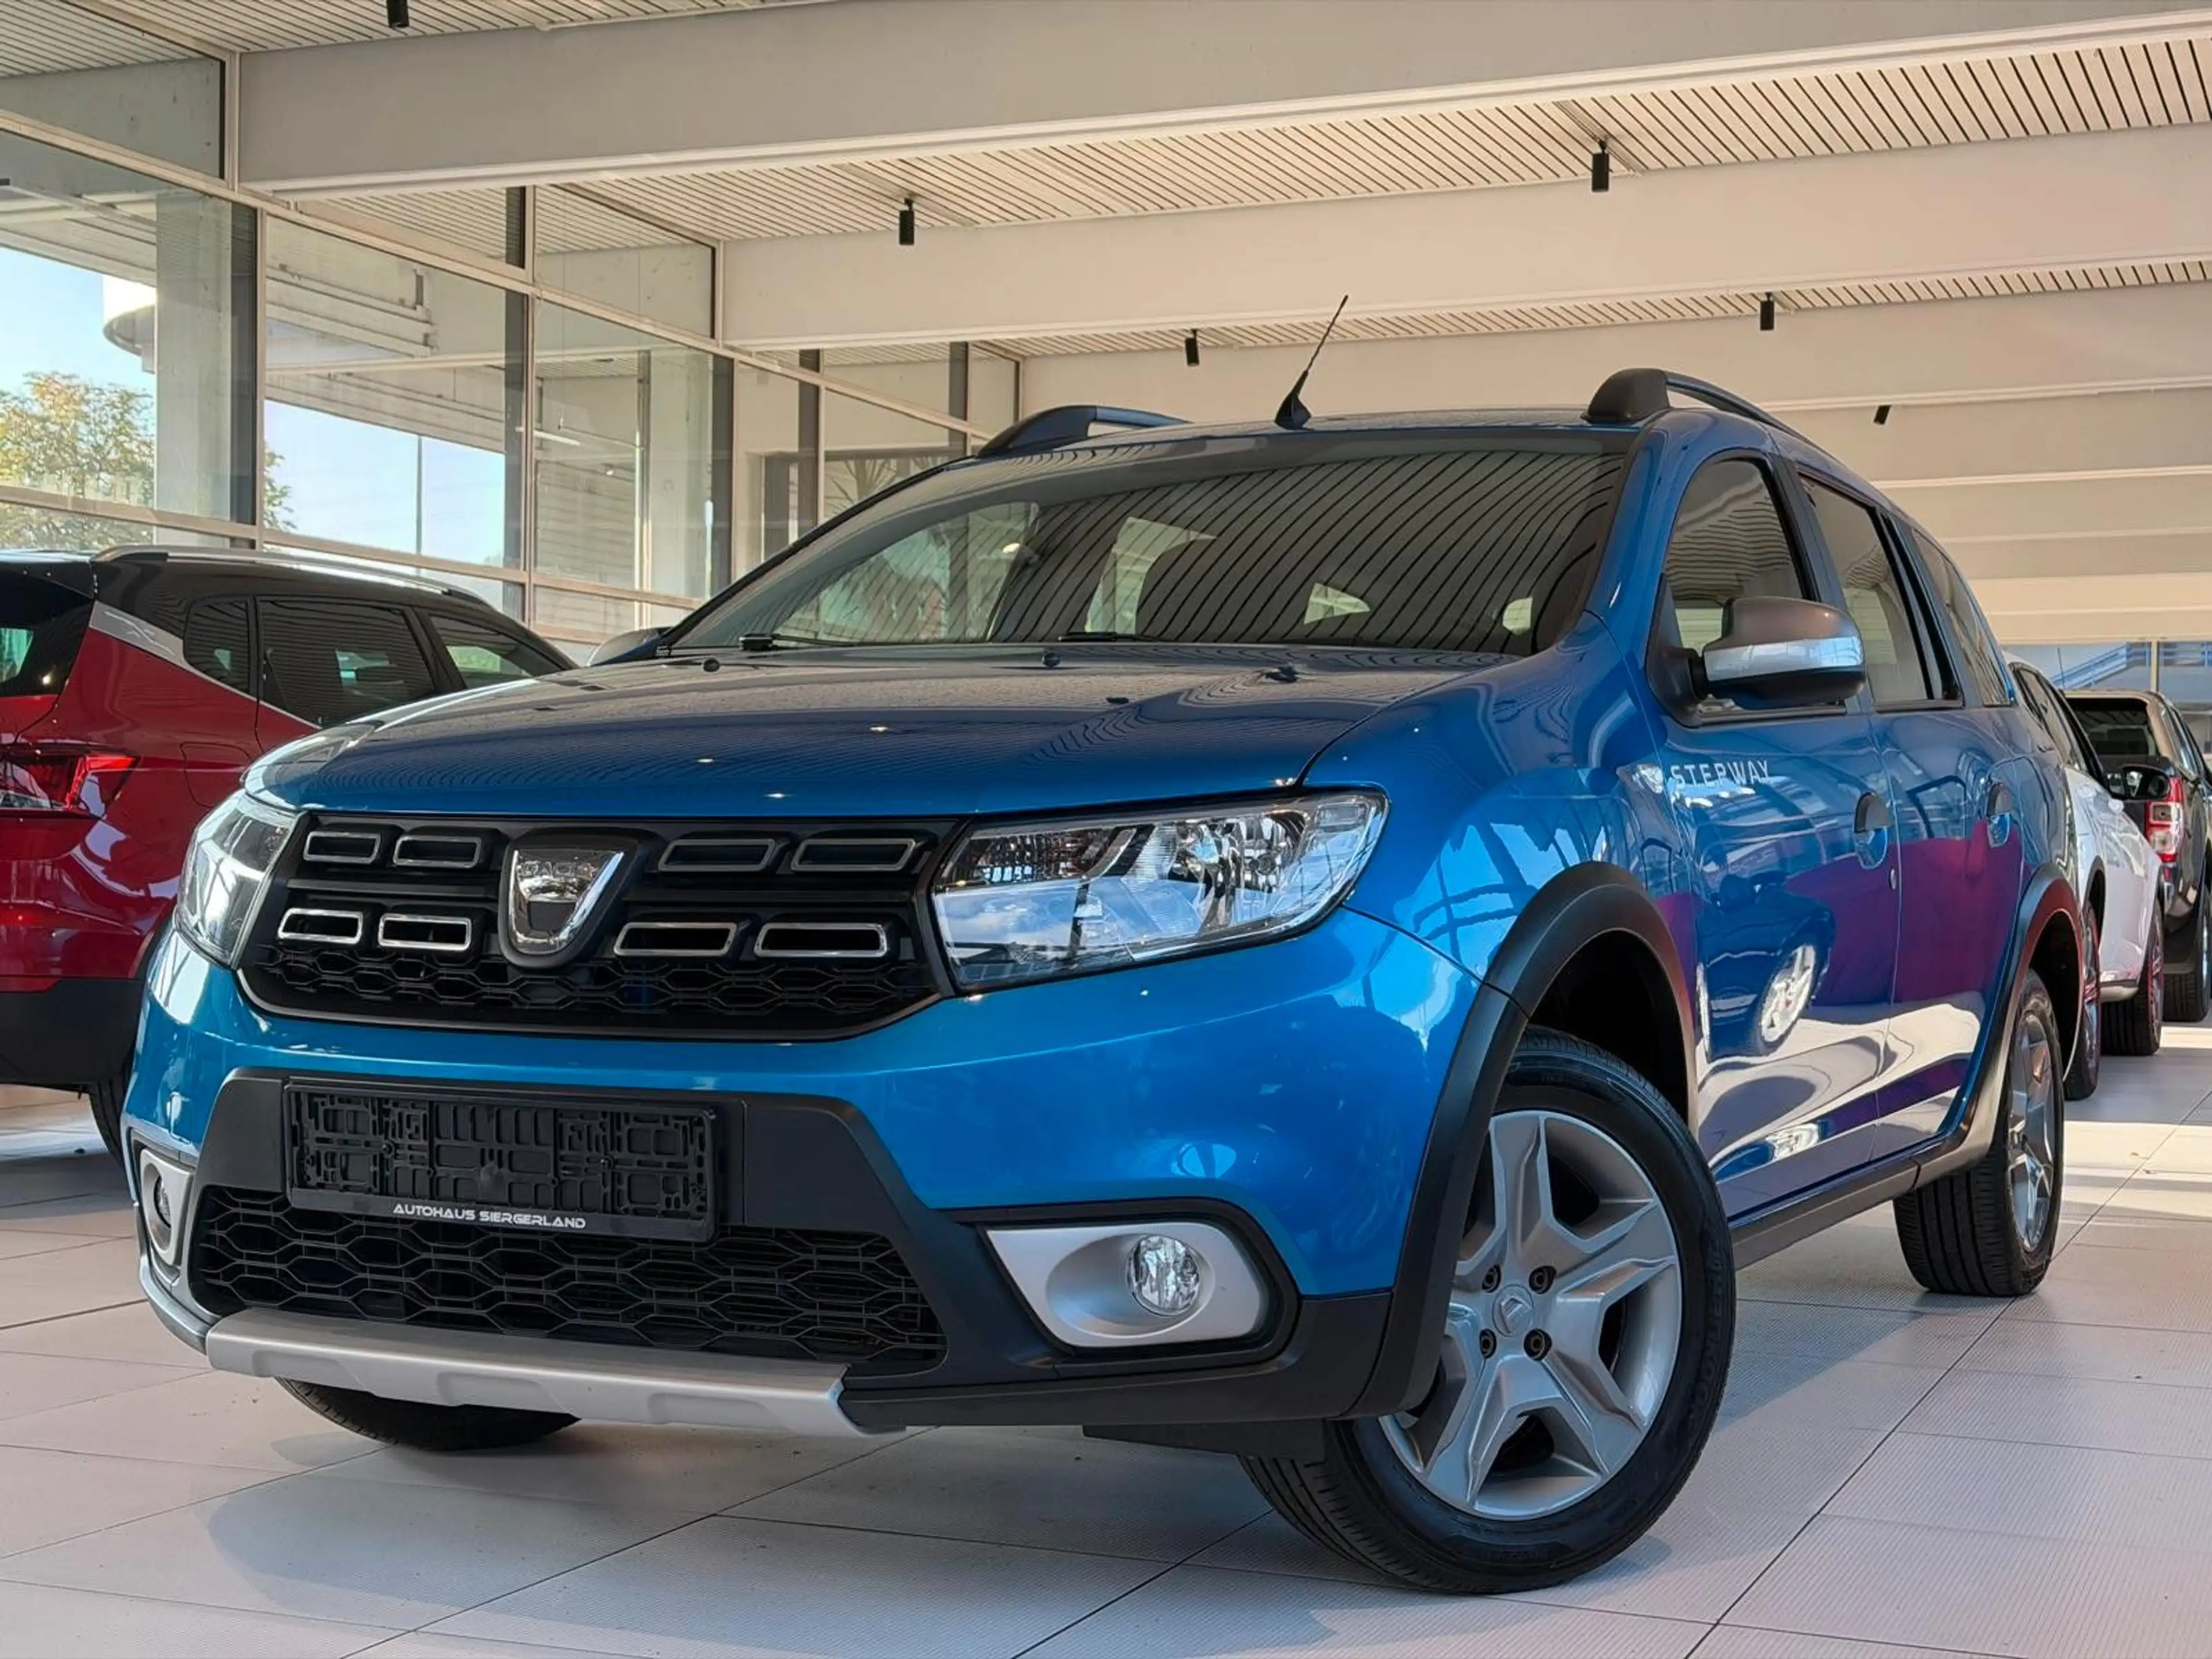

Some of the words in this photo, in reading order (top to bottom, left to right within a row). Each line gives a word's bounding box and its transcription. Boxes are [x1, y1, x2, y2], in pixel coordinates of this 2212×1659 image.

[1671, 759, 1771, 789] STEPWAY
[393, 1203, 476, 1221] AUTOHAUS
[479, 1210, 586, 1229] SIERGERLAND
